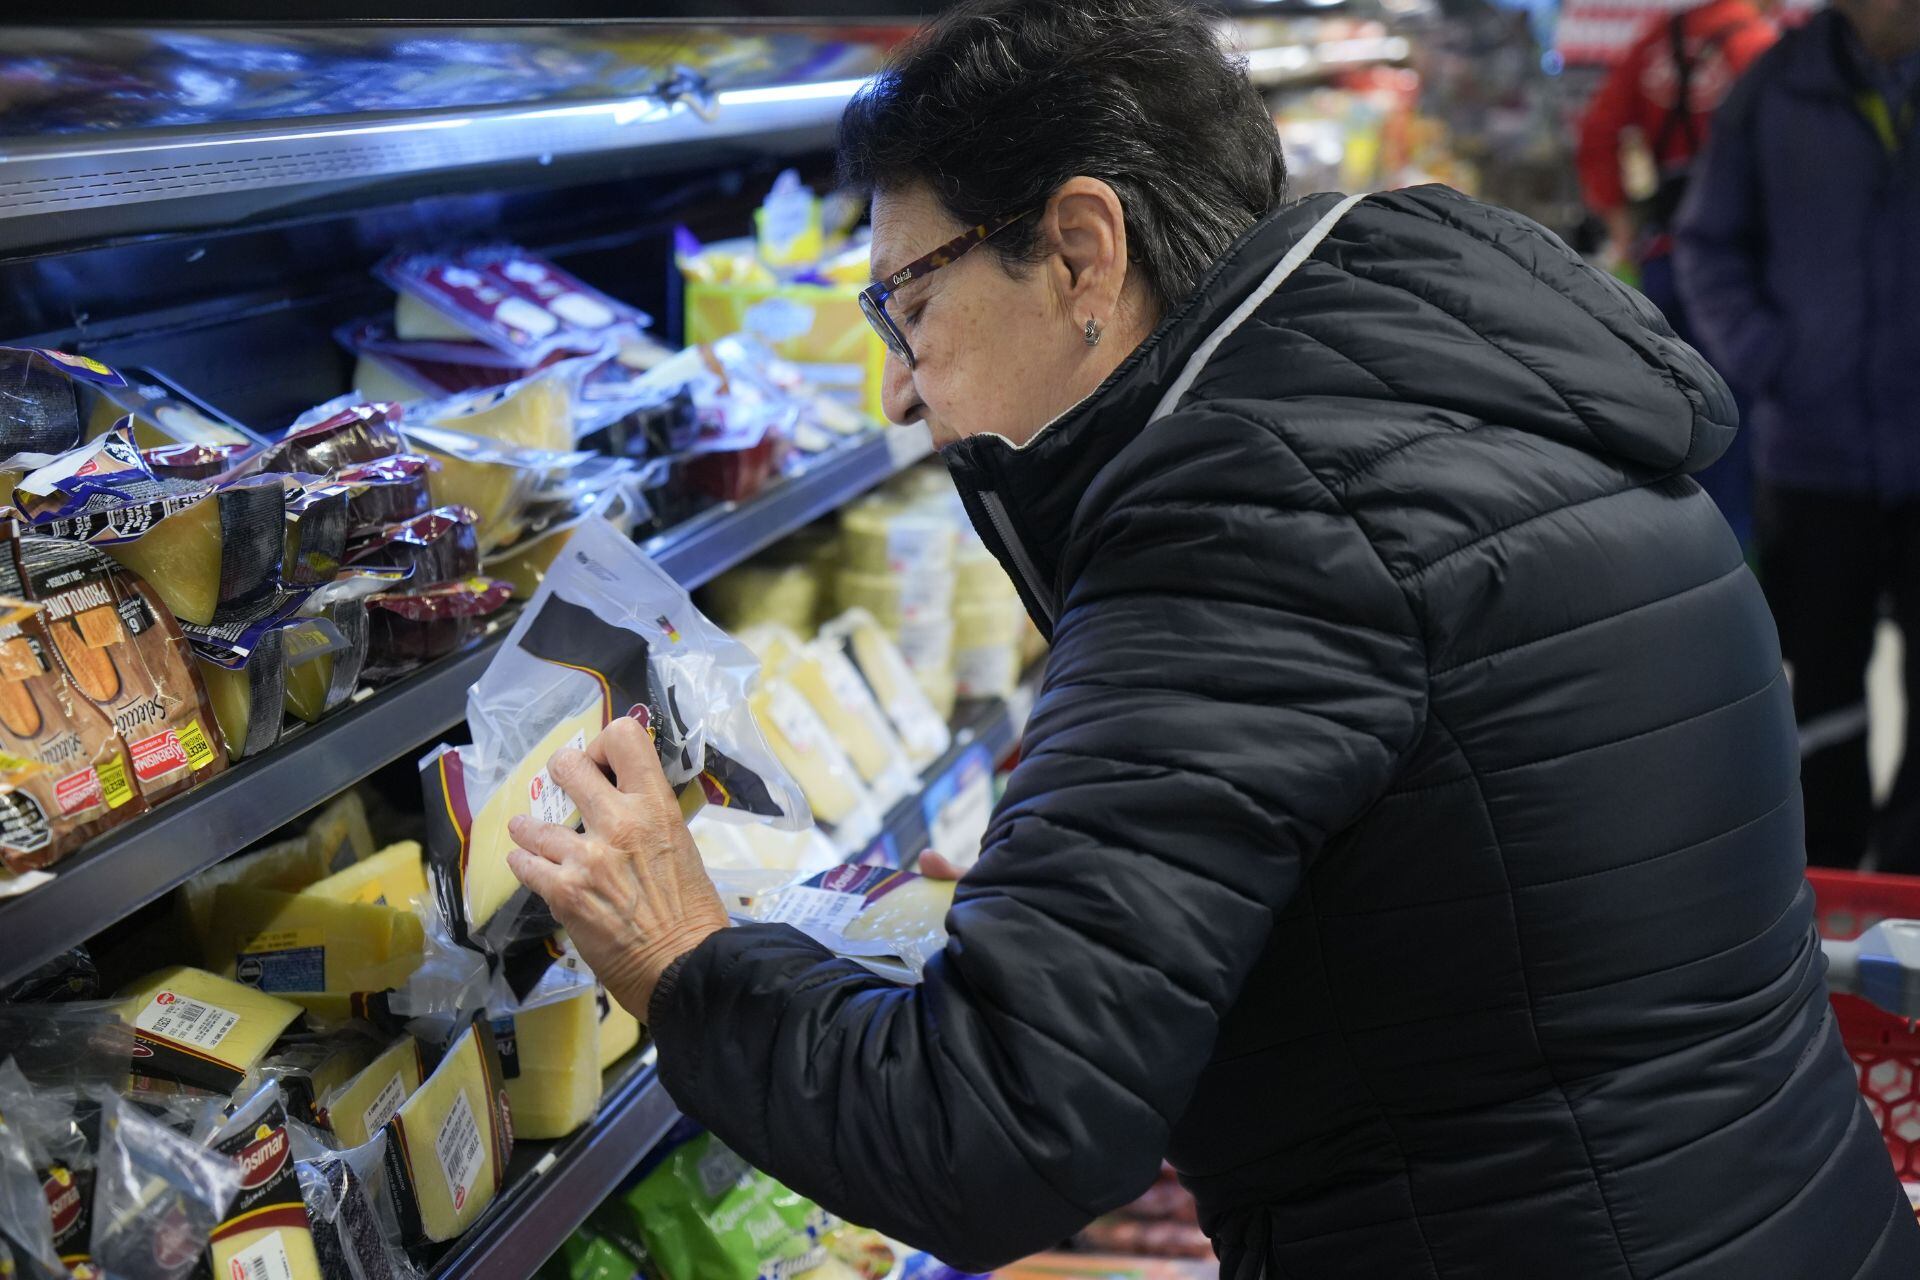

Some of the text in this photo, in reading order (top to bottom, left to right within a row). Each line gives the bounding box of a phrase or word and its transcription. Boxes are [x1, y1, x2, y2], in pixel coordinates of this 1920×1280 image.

[41, 582, 112, 620] PROVOLONE
[128, 617, 140, 632] 6
[238, 1132, 285, 1176] Josimar
